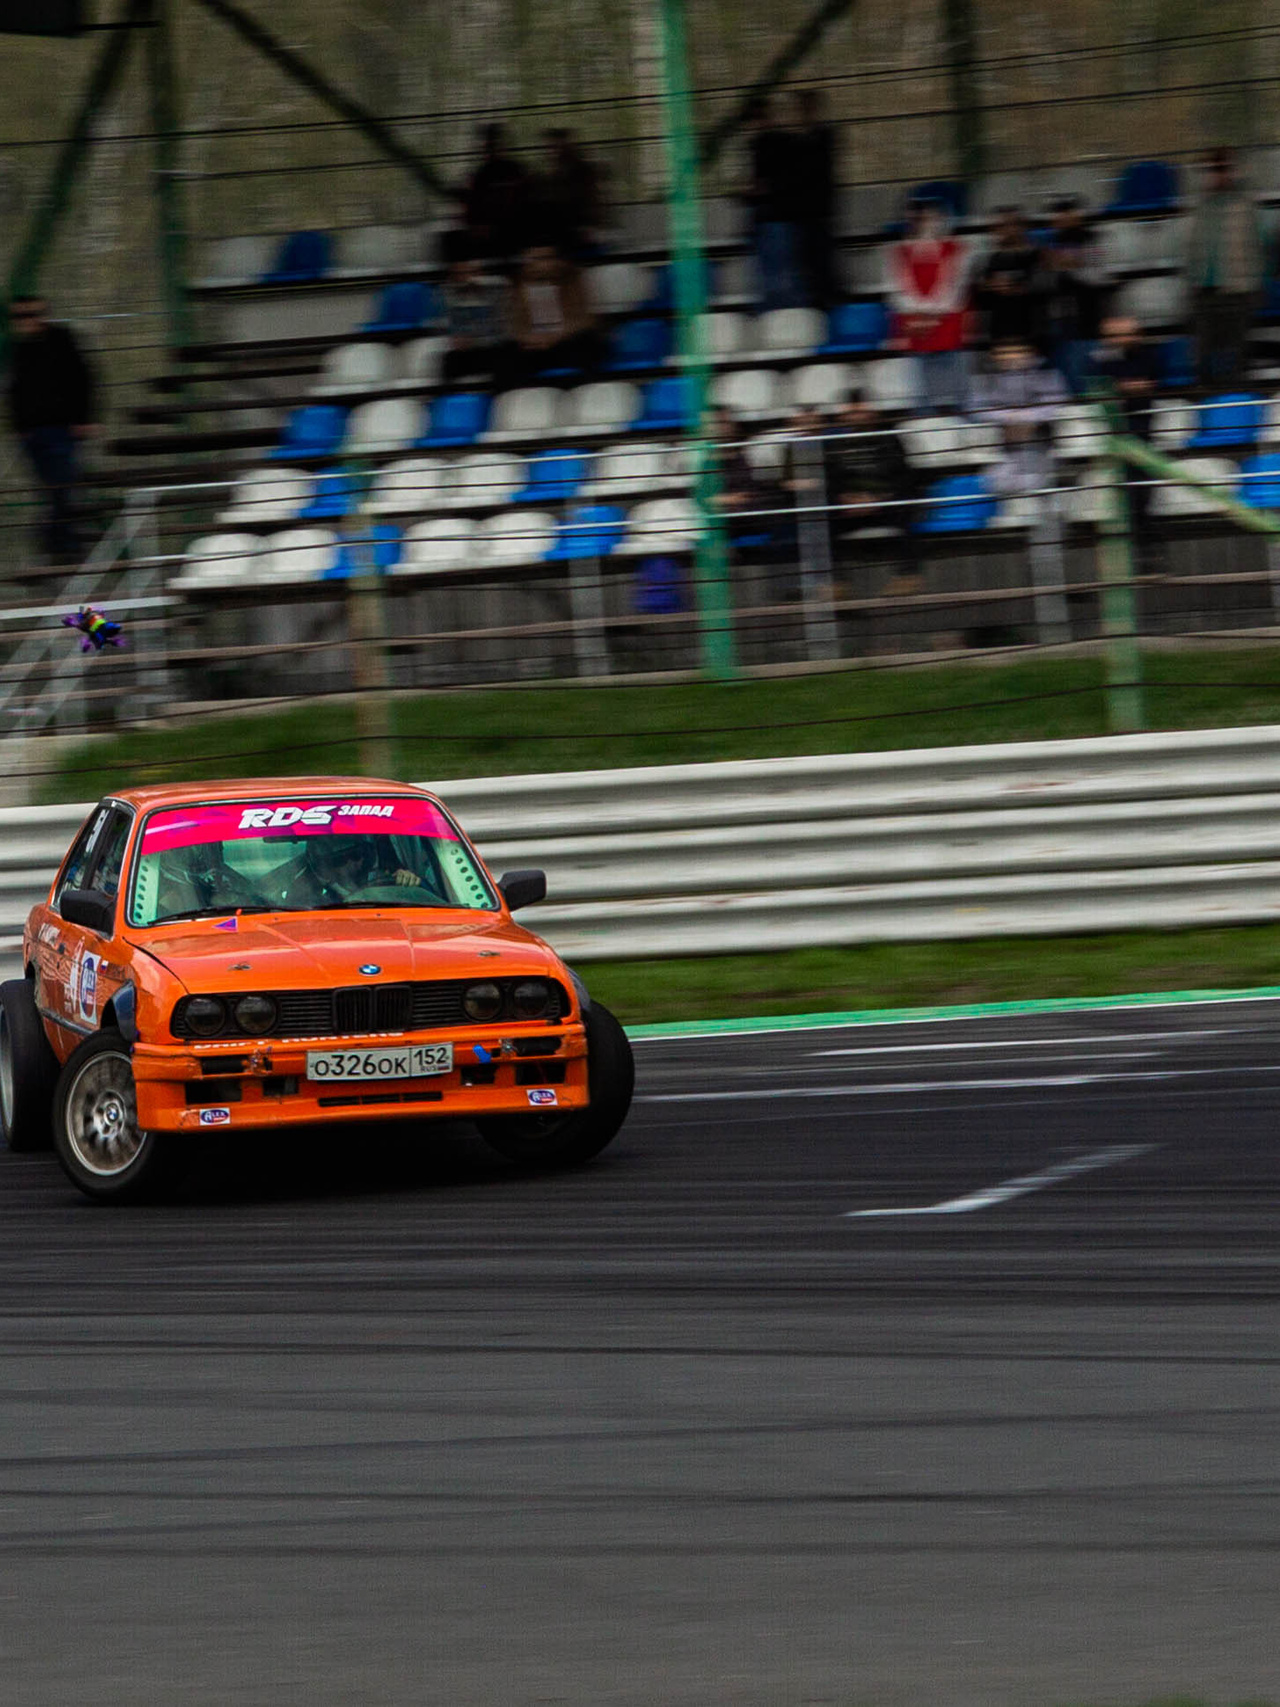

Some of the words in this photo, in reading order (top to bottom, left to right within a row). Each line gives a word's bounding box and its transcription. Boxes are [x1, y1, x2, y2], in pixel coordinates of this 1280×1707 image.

[238, 805, 337, 829] RDS
[338, 804, 395, 818] ЗАПАД
[414, 1047, 447, 1066] 152
